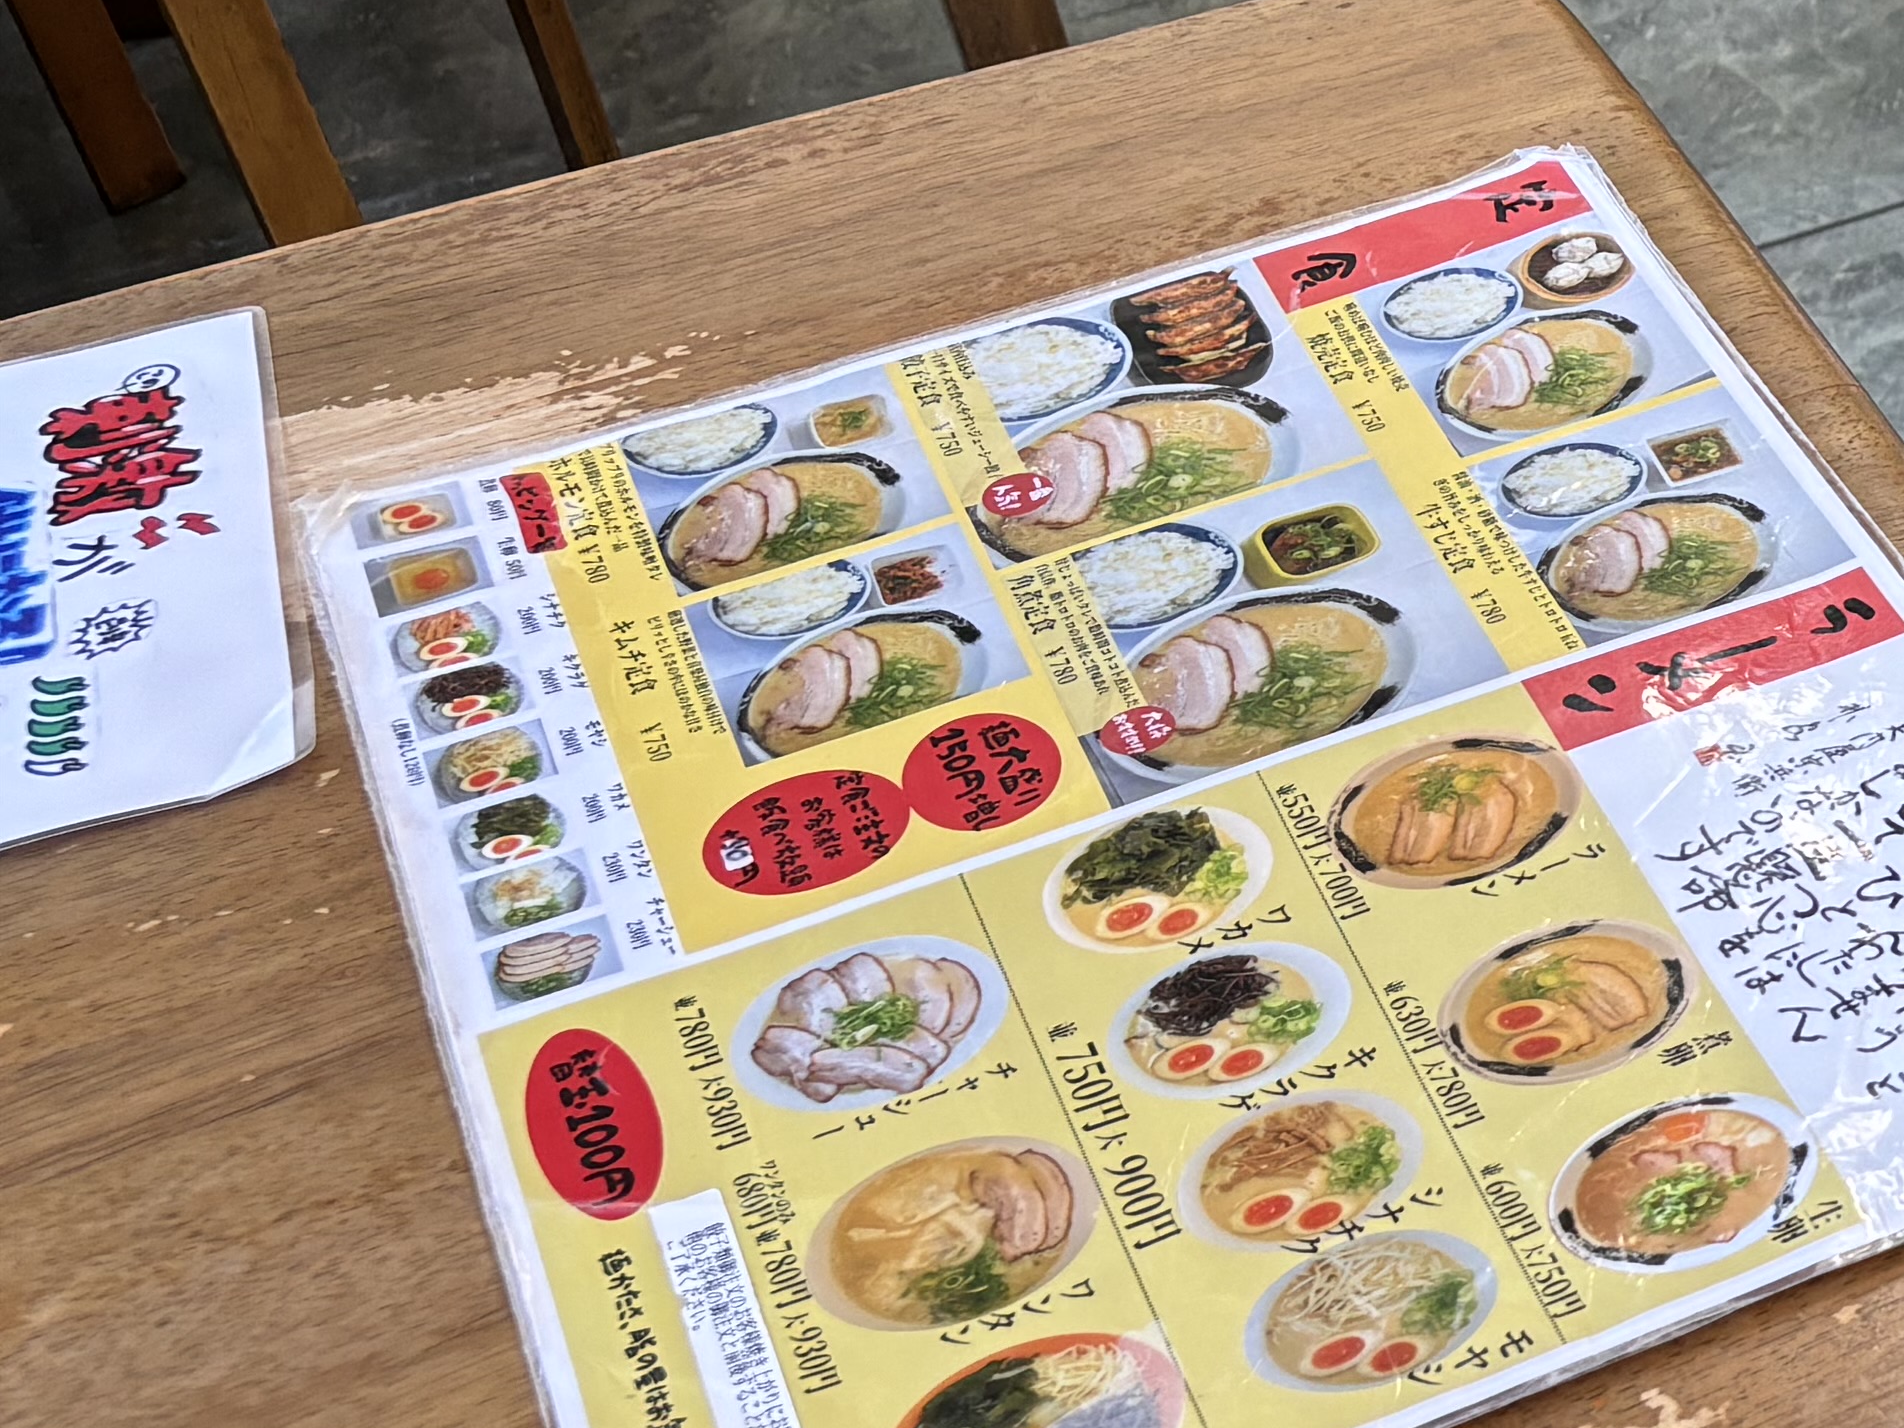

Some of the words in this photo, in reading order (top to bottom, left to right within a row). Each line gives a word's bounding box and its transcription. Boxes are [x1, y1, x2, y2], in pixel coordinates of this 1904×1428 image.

[1292, 180, 1553, 291] 定食
[898, 353, 942, 407] 餃子定食
[930, 421, 963, 456] ¥750
[1306, 332, 1353, 384] 焼売定食
[1351, 399, 1385, 432] ¥750
[40, 388, 204, 526] 刺激
[549, 457, 599, 540] ホルモン定食
[577, 543, 609, 583] ¥780
[53, 534, 136, 583] が
[1416, 503, 1475, 573] 牛すじ定食
[1470, 588, 1506, 624] ¥780
[538, 593, 566, 628] シナチク
[1008, 574, 1056, 634] 角煮定食
[1044, 645, 1077, 685] ¥780
[562, 653, 588, 688] キクラゲ
[1563, 598, 1874, 712] ラーメン
[609, 620, 657, 694] キムチ定食
[639, 722, 672, 762] ¥750
[584, 719, 607, 747] モヤシ
[979, 721, 1041, 805] 麺大盛り
[606, 782, 630, 810] ワカメ
[928, 728, 999, 830] 150円増し
[753, 797, 811, 886] 飯食べ放題
[801, 797, 842, 858] お客様は
[835, 770, 890, 859] 定食ご注文の
[626, 839, 652, 877] ワンタン
[1471, 843, 1605, 896] ラーメン
[645, 897, 675, 954] チャーシュー
[1178, 904, 1291, 954] ワカメ
[1220, 1047, 1375, 1110] キクラゲ
[1658, 1030, 1732, 1066] 煮卵
[551, 1050, 634, 1202] 替玉100円
[813, 1062, 1017, 1139] チャーシュー
[759, 1159, 795, 1224] ワンタンのみ
[1281, 1187, 1442, 1253] シナチク
[1767, 1200, 1842, 1243] 生卵
[667, 1238, 706, 1331] ご了承ください。
[940, 1278, 1094, 1344] ワンタン
[1402, 1330, 1533, 1385] モヤシ
